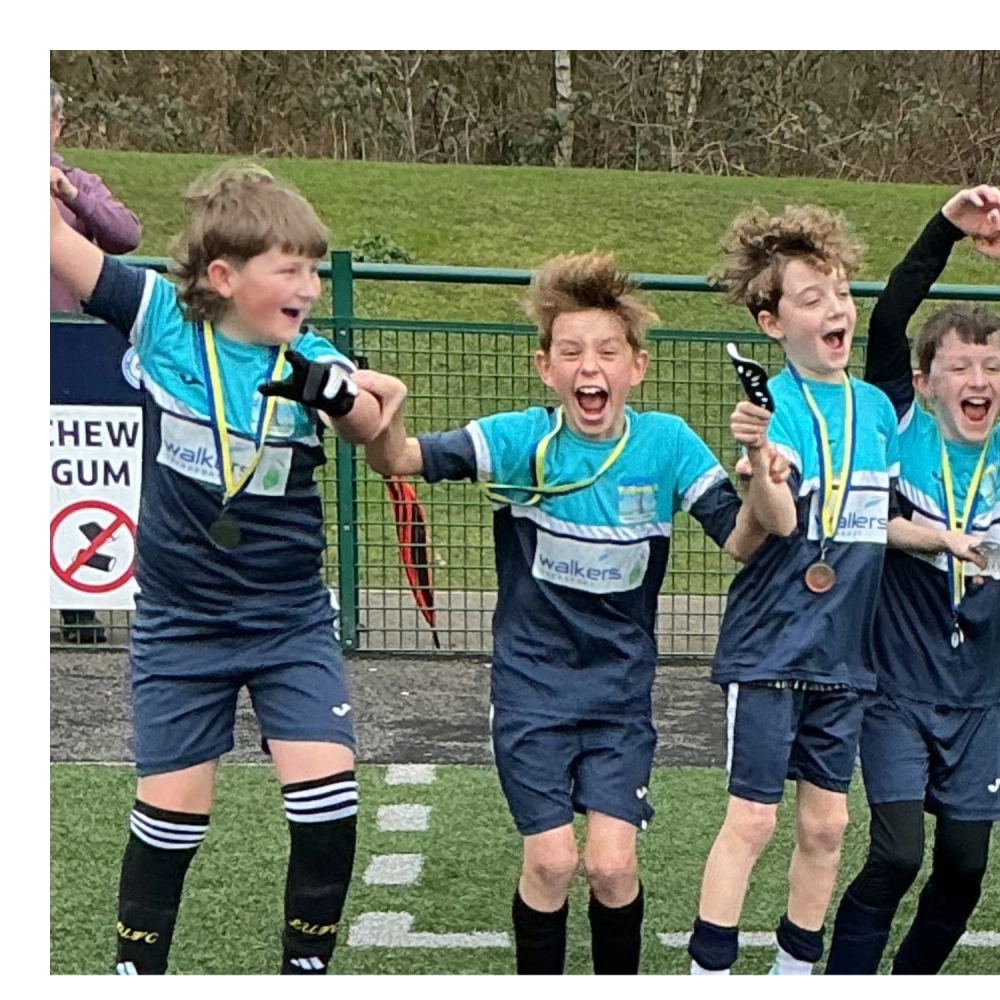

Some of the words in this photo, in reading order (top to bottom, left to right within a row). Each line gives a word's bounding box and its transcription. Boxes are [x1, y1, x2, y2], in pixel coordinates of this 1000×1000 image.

[50, 420, 139, 447] HEW
[51, 459, 131, 486] GUM
[539, 554, 622, 580] walkers
